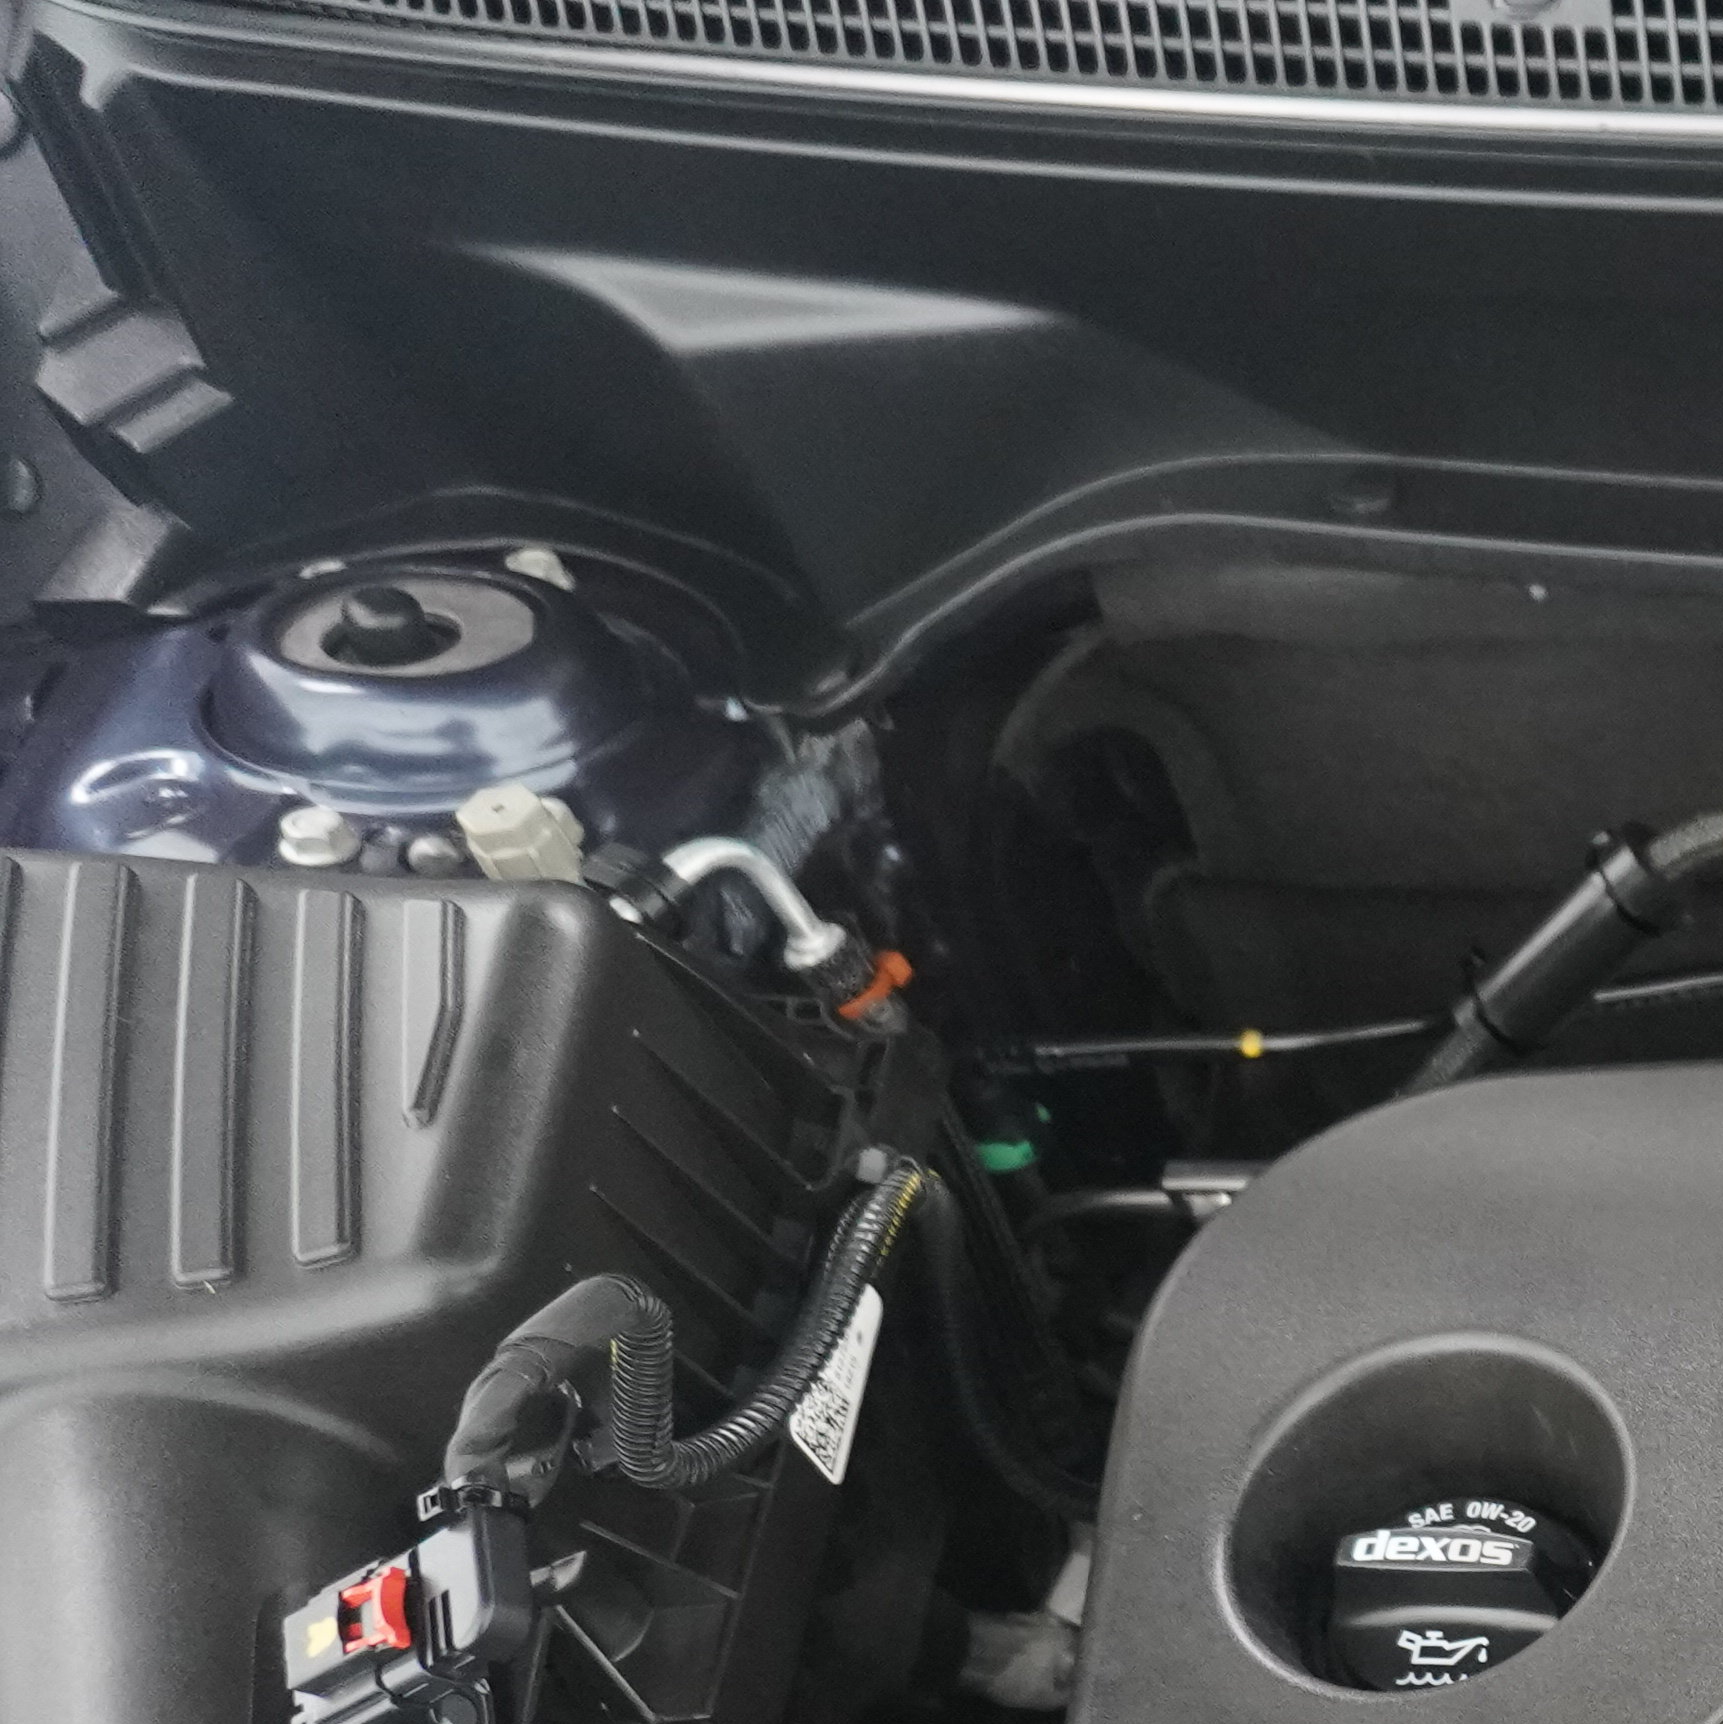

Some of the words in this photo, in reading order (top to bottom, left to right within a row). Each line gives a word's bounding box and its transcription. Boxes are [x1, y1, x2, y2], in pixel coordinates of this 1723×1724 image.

[1407, 1502, 1455, 1529] SAE
[1465, 1500, 1537, 1533] 0W-20
[1353, 1528, 1515, 1566] dexos
